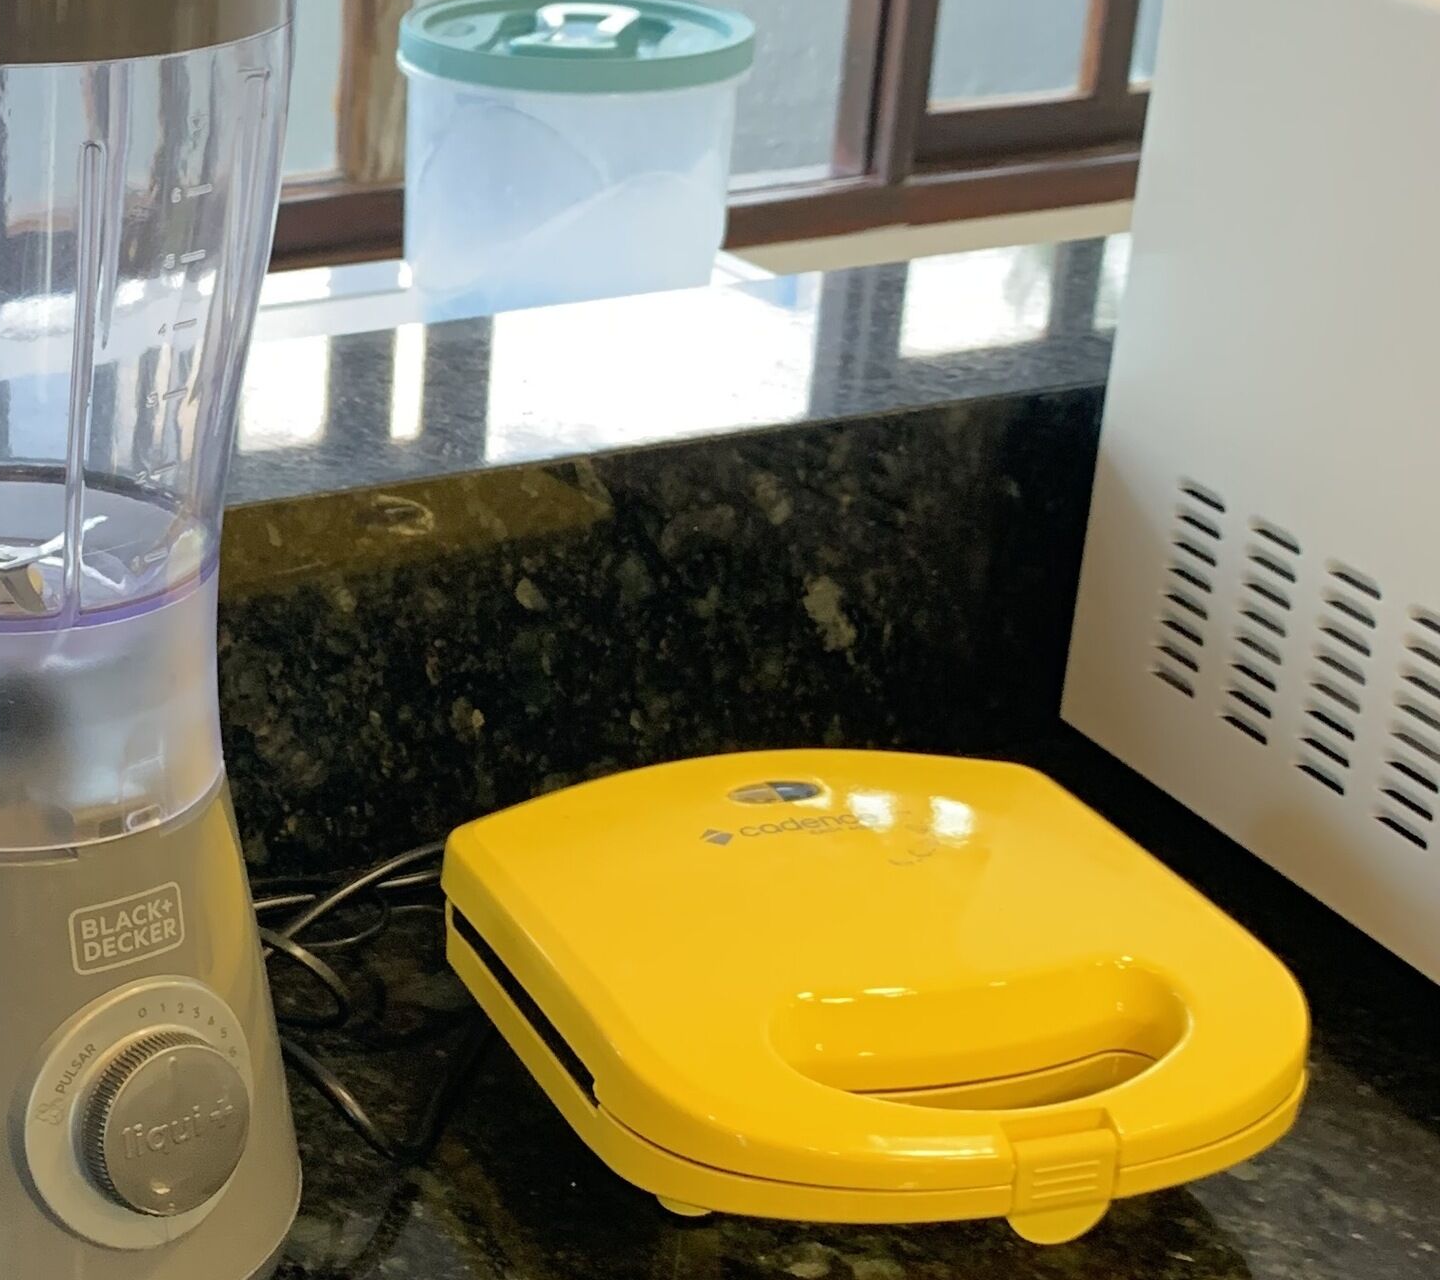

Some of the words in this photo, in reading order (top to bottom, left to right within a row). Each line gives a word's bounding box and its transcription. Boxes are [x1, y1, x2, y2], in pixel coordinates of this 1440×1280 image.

[81, 899, 173, 940] BLACK+
[83, 918, 177, 961] DECKER
[138, 1007, 147, 1019] 0
[160, 1003, 166, 1013] 1
[177, 1002, 185, 1014] 2
[192, 1006, 200, 1019] 3
[220, 1026, 228, 1039] 5
[54, 1043, 96, 1094] PULSAR
